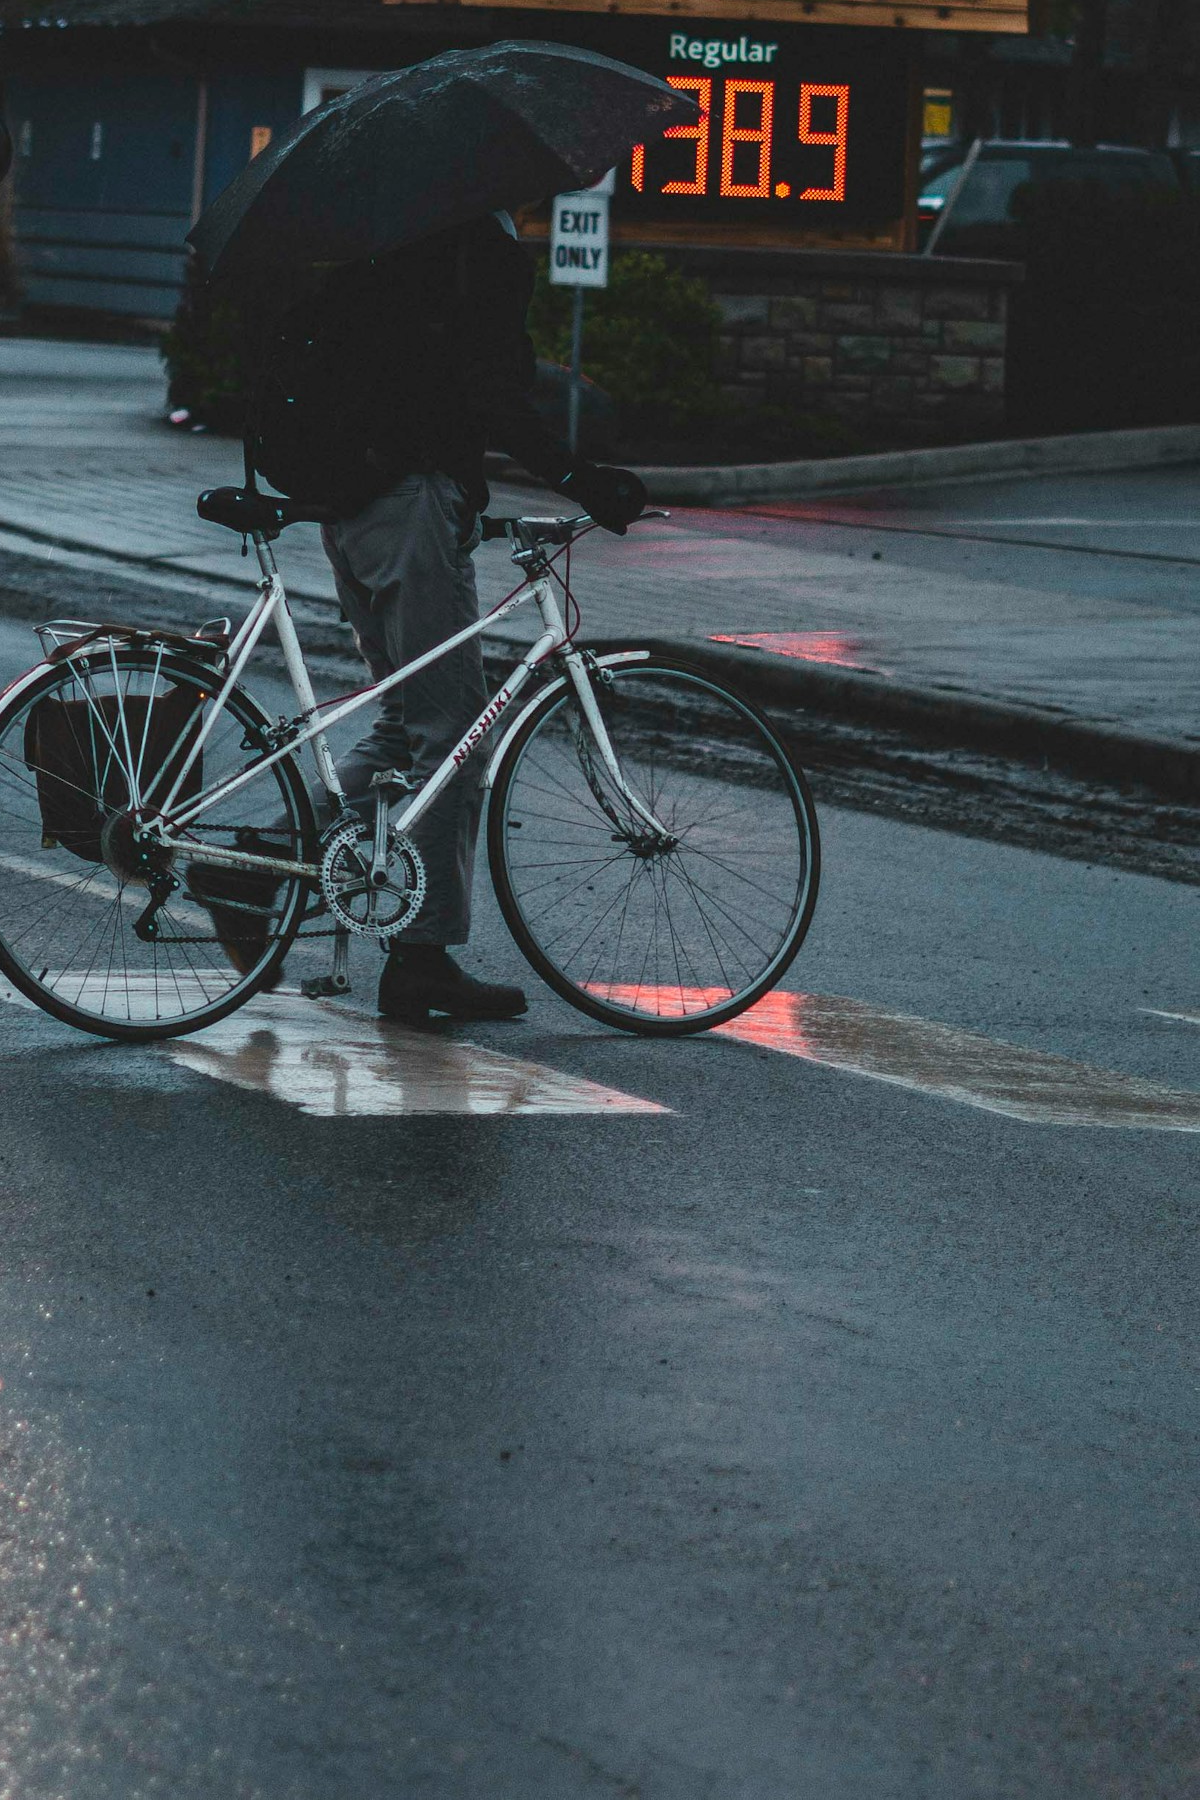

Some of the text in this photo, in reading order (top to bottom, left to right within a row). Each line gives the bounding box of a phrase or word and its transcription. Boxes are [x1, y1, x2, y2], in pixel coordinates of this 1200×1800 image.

[670, 33, 778, 67] Regular
[560, 209, 600, 234] EXIT
[555, 244, 601, 269] ONLY
[453, 687, 512, 766] NISHIKI
